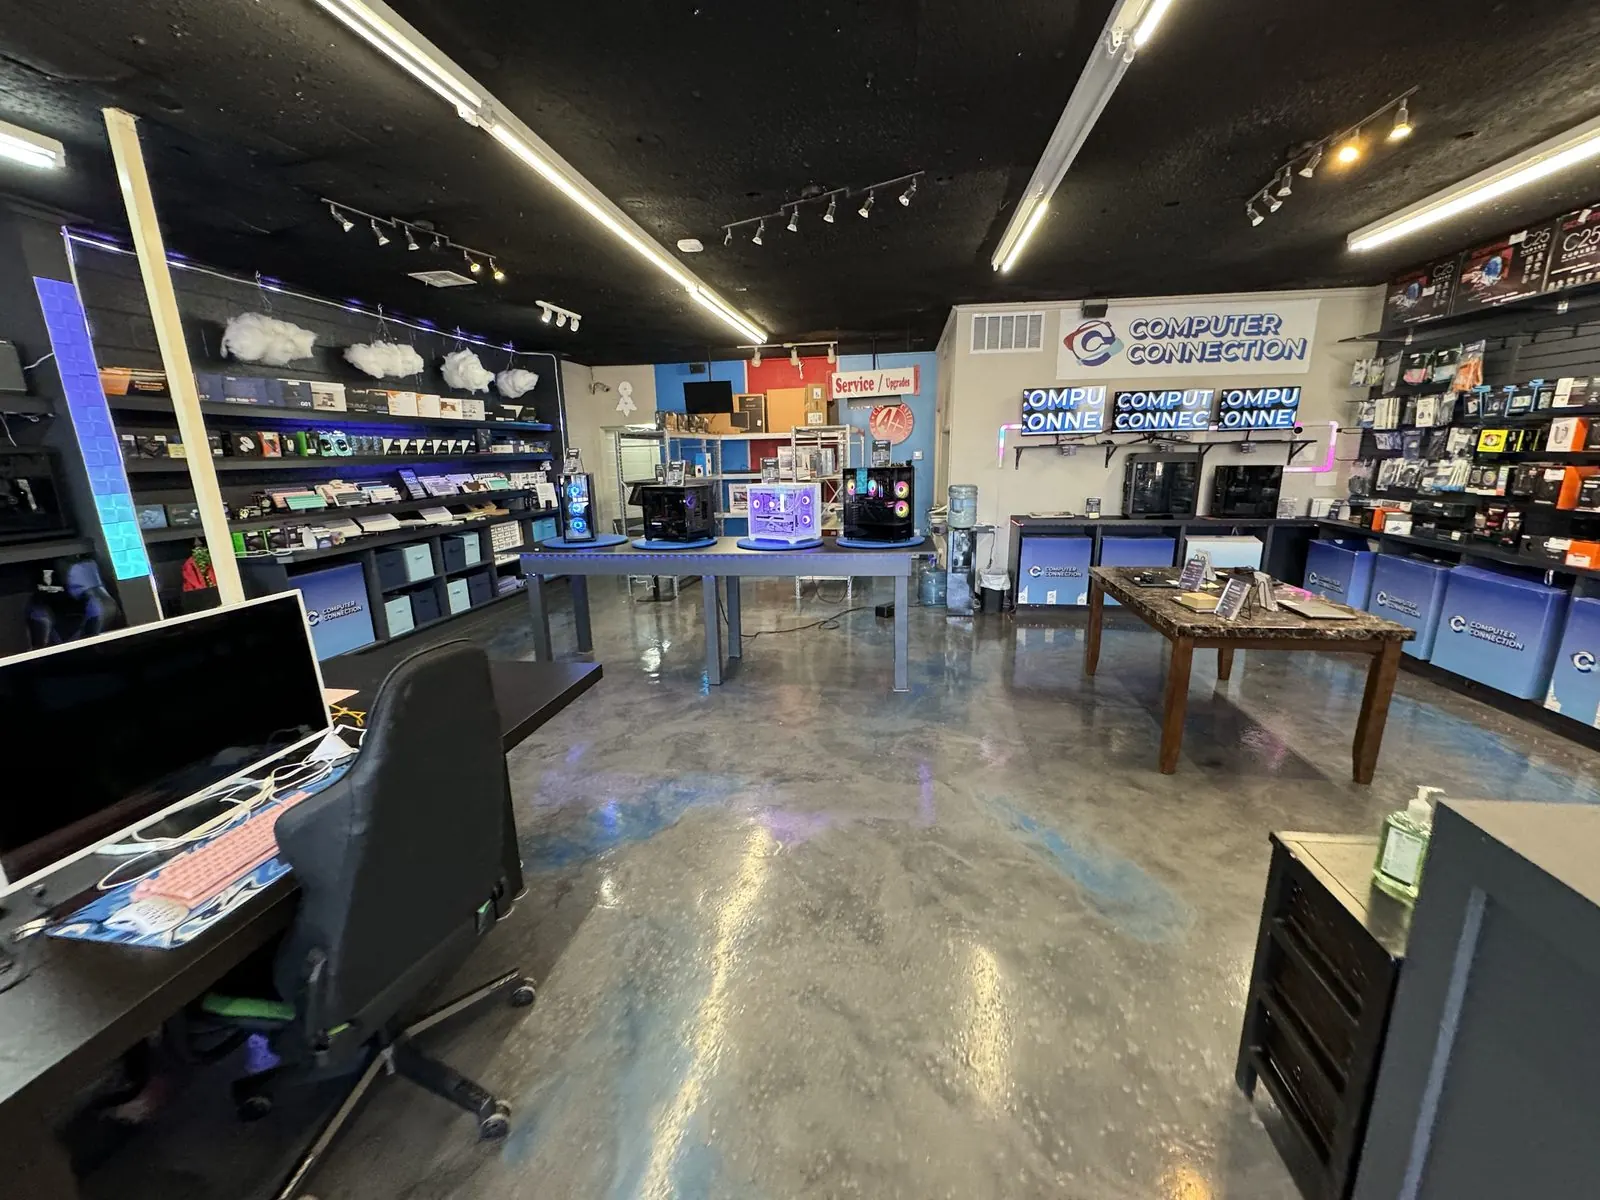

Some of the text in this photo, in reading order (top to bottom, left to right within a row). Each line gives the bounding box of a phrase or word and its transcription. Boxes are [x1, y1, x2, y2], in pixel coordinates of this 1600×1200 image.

[1521, 227, 1551, 249] C25
[1563, 225, 1600, 252] C25
[1128, 313, 1282, 341] COMPUTER
[1126, 338, 1308, 364] CONNECTION
[835, 376, 875, 393] Service
[885, 377, 910, 391] Upgrades
[1023, 388, 1104, 410] OMPU
[1117, 390, 1214, 411] COMPUT
[1221, 388, 1298, 410] OMPU
[1022, 410, 1103, 431] ONNE
[1115, 410, 1210, 429] CONNEC
[1219, 409, 1297, 430] ONNE
[323, 600, 356, 615] COMPUTER
[323, 605, 363, 621] CONNECTION
[1468, 628, 1525, 651] CONNECTION
[1469, 621, 1517, 639] COMPUTER
